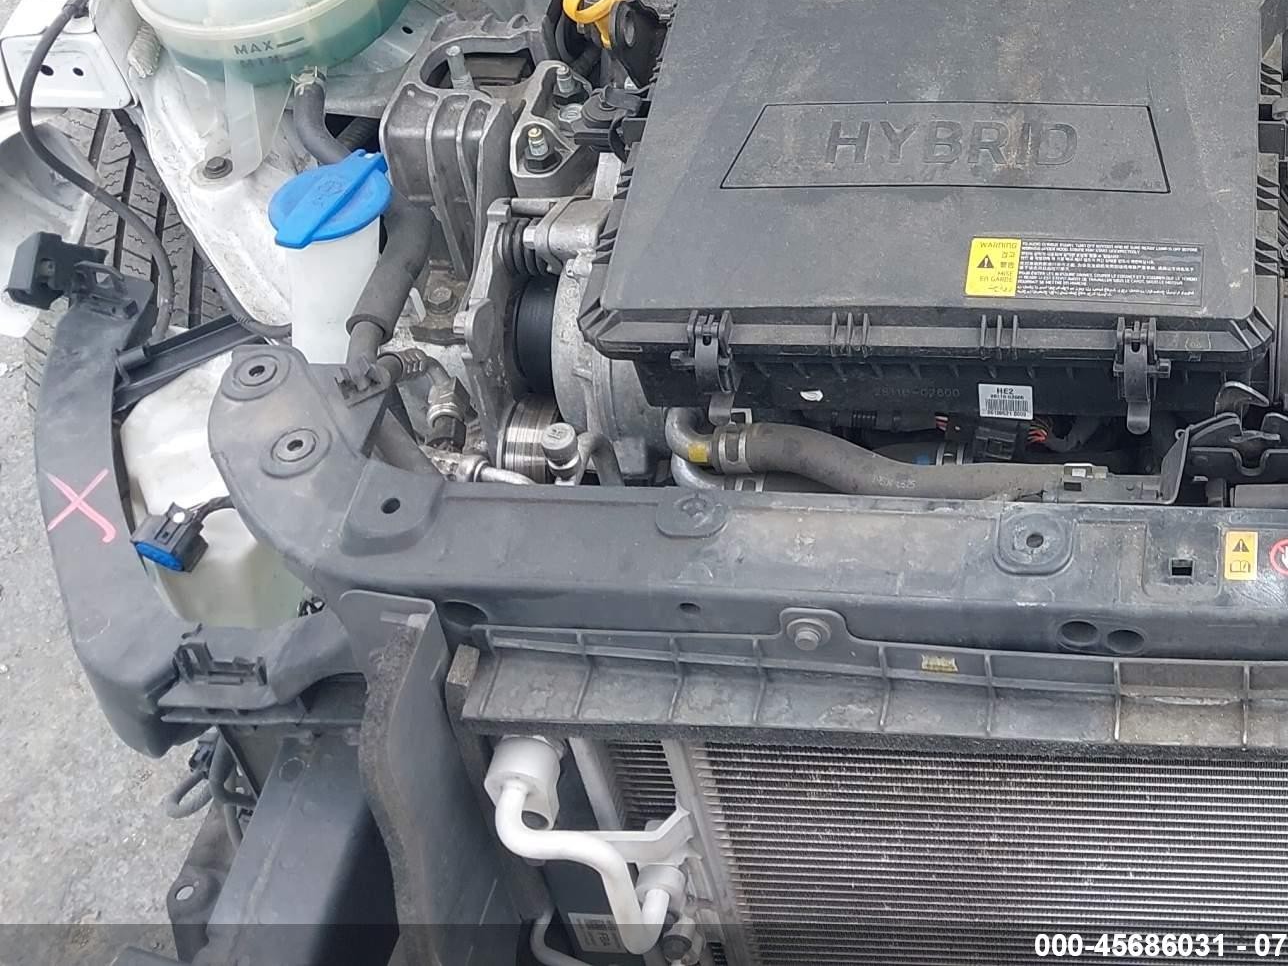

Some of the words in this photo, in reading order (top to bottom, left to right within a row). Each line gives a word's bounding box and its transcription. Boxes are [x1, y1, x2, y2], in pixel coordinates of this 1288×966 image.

[233, 40, 274, 55] MAX
[824, 120, 1079, 167] HYBRID
[980, 241, 1017, 249] WARNING
